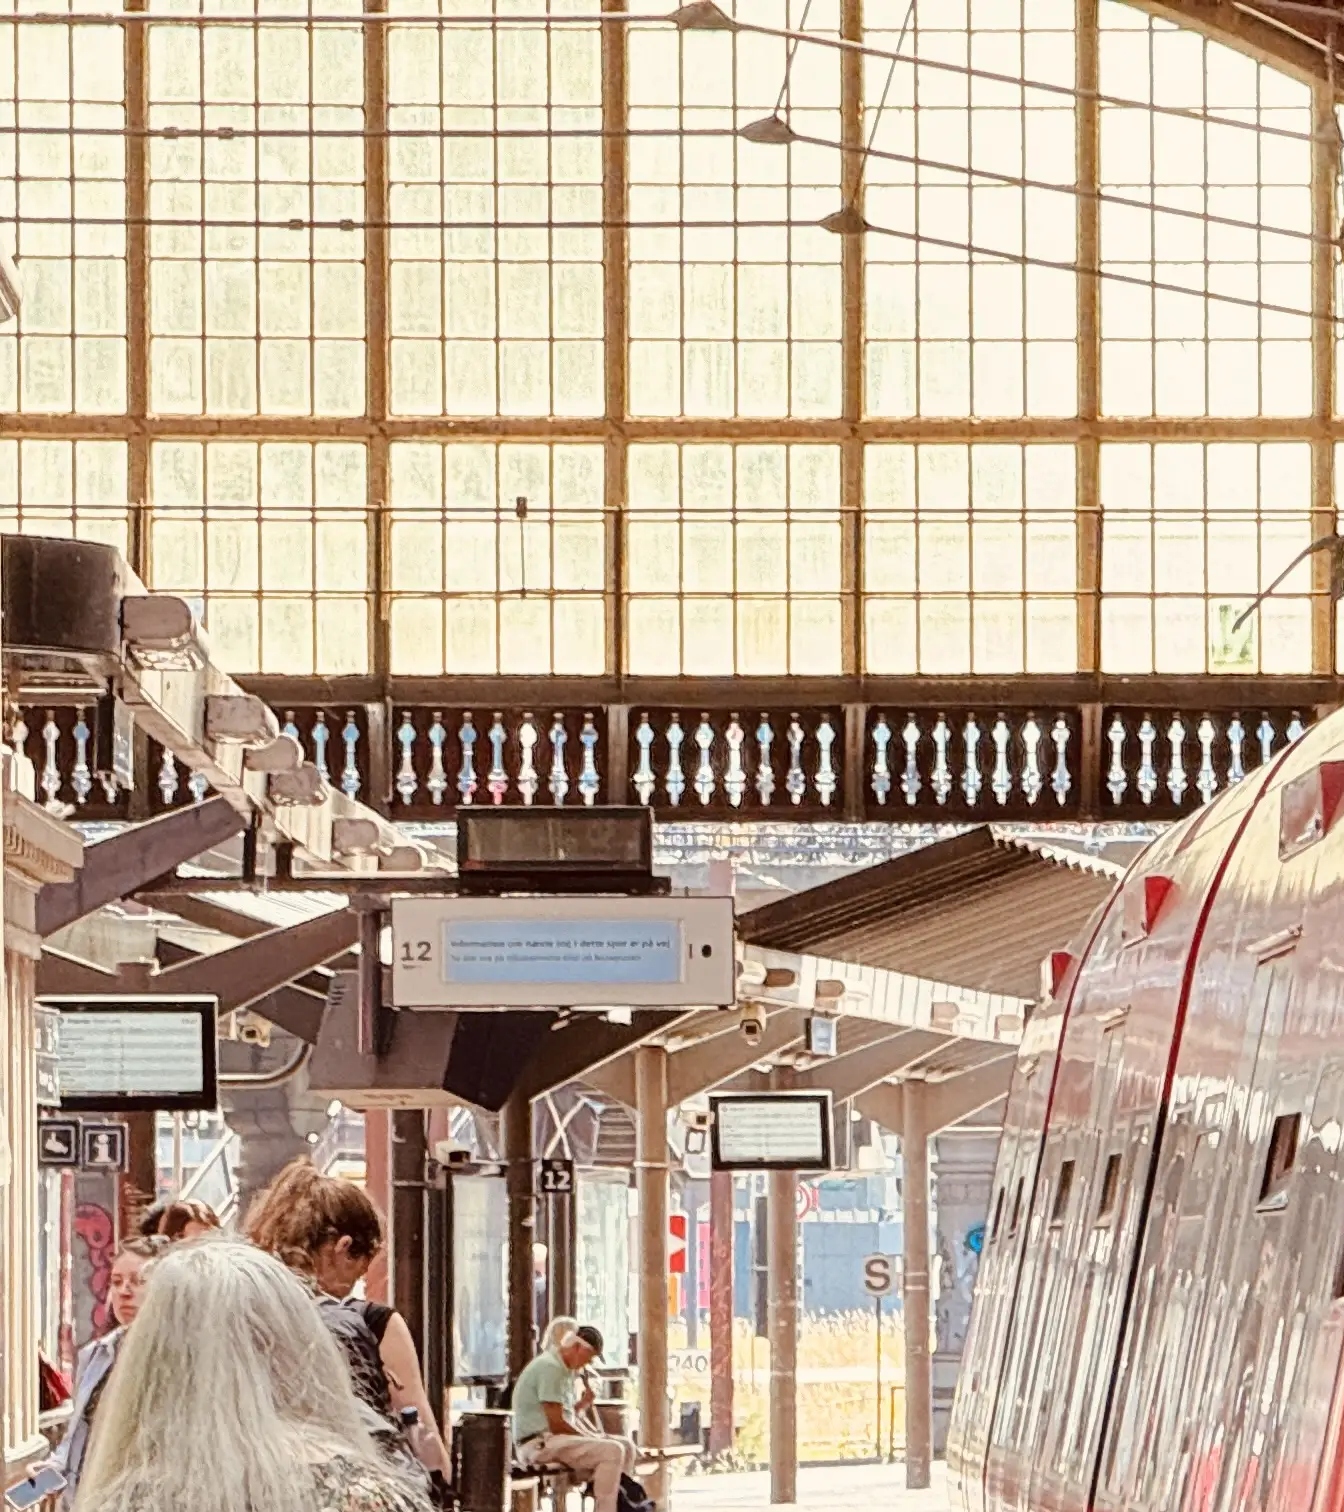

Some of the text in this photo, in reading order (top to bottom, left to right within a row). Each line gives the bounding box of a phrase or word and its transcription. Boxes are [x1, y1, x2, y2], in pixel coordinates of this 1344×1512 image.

[400, 941, 432, 961] 12
[544, 1170, 571, 1190] 12
[864, 1258, 891, 1292] S
